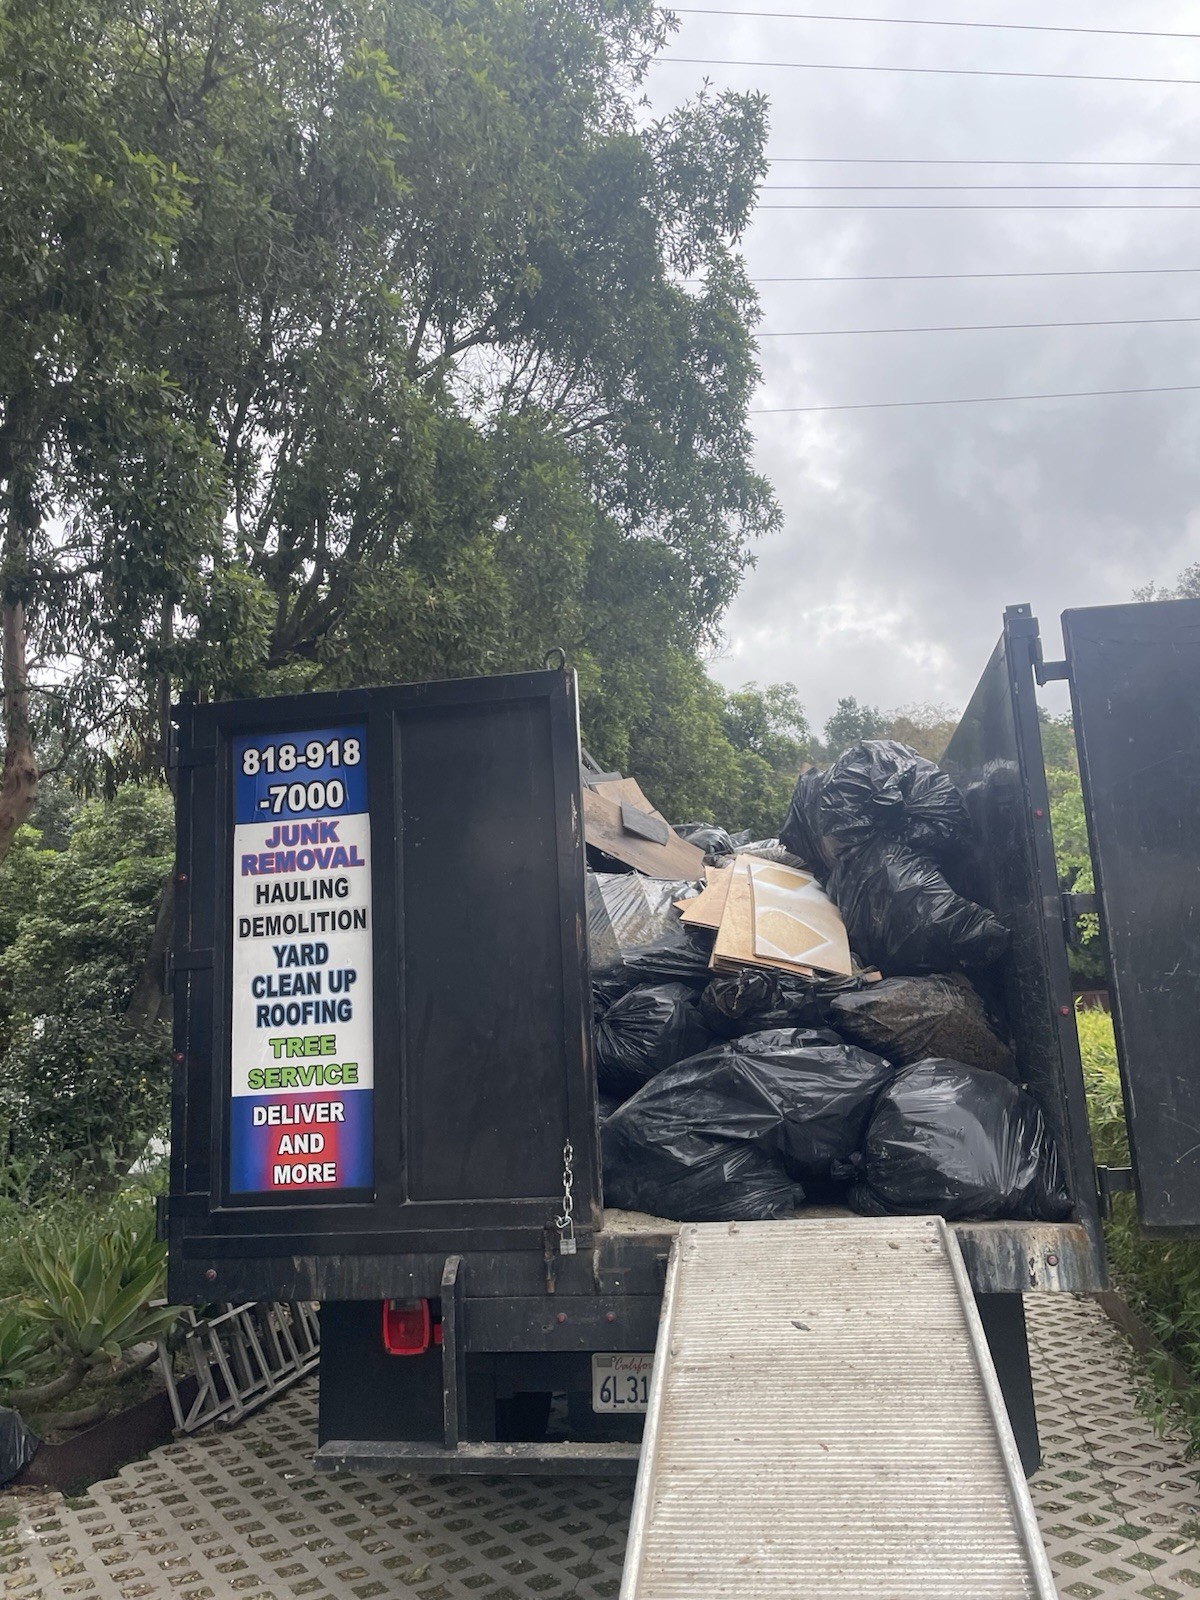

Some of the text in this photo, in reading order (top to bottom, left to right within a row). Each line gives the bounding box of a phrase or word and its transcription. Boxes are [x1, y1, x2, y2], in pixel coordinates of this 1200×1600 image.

[242, 738, 361, 777] 818-918
[259, 780, 345, 815] -7000
[265, 820, 340, 849] JUNK
[241, 845, 365, 876] REMOVAL
[256, 877, 349, 905] HAULING
[239, 908, 367, 938] DEMOLITION
[273, 942, 329, 969] YARD
[252, 969, 357, 999] CLEAN UP
[256, 999, 353, 1028] ROOFING
[269, 1034, 337, 1059] TREE
[247, 1062, 359, 1090] SERVICE
[253, 1101, 345, 1127] DELIVER
[278, 1132, 325, 1155] AND
[273, 1162, 337, 1185] MORE
[600, 1375, 648, 1404] 6L31
